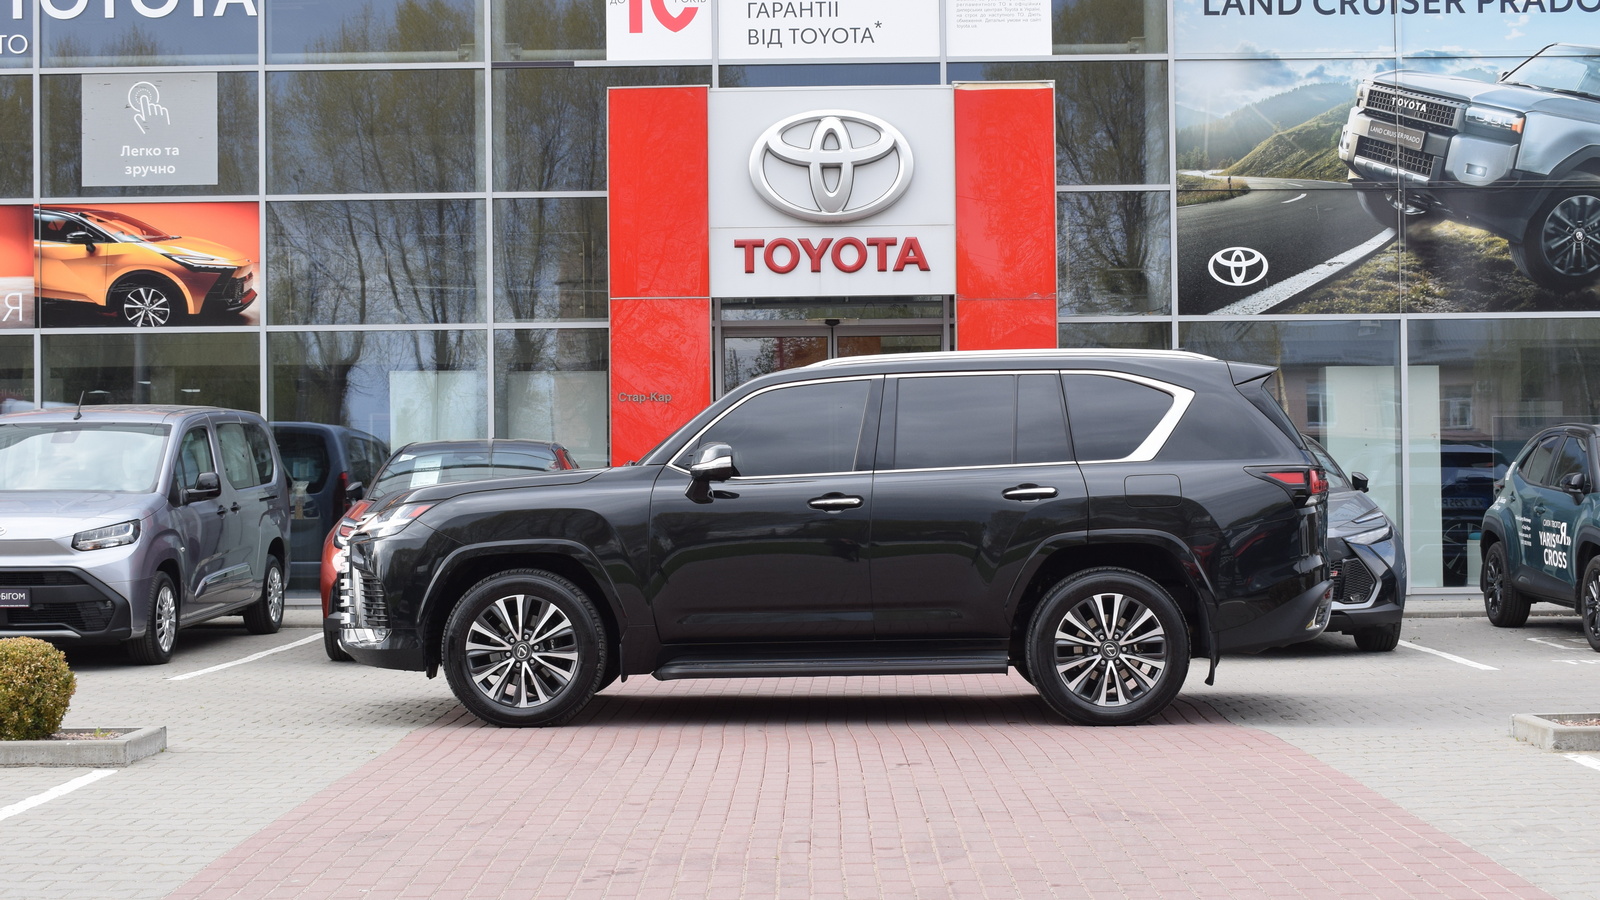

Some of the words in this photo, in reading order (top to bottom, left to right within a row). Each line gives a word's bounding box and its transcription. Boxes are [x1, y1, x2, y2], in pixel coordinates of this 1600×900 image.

[748, 29, 782, 48] ВІД
[1391, 97, 1427, 113] TOYOTA
[1370, 126, 1383, 134] LAND
[1383, 129, 1404, 139] CRUISER
[1404, 134, 1421, 144] PRADO
[120, 145, 162, 157] Легко
[164, 146, 180, 156] та
[124, 164, 176, 177] зручно
[733, 236, 931, 274] TOYOTA
[8, 388, 57, 396] ЧАСТИ
[618, 392, 672, 404] Стар-Кар
[1538, 531, 1556, 548] YARIS
[1543, 548, 1567, 569] CROSS
[0, 592, 26, 600] БІГОМ
